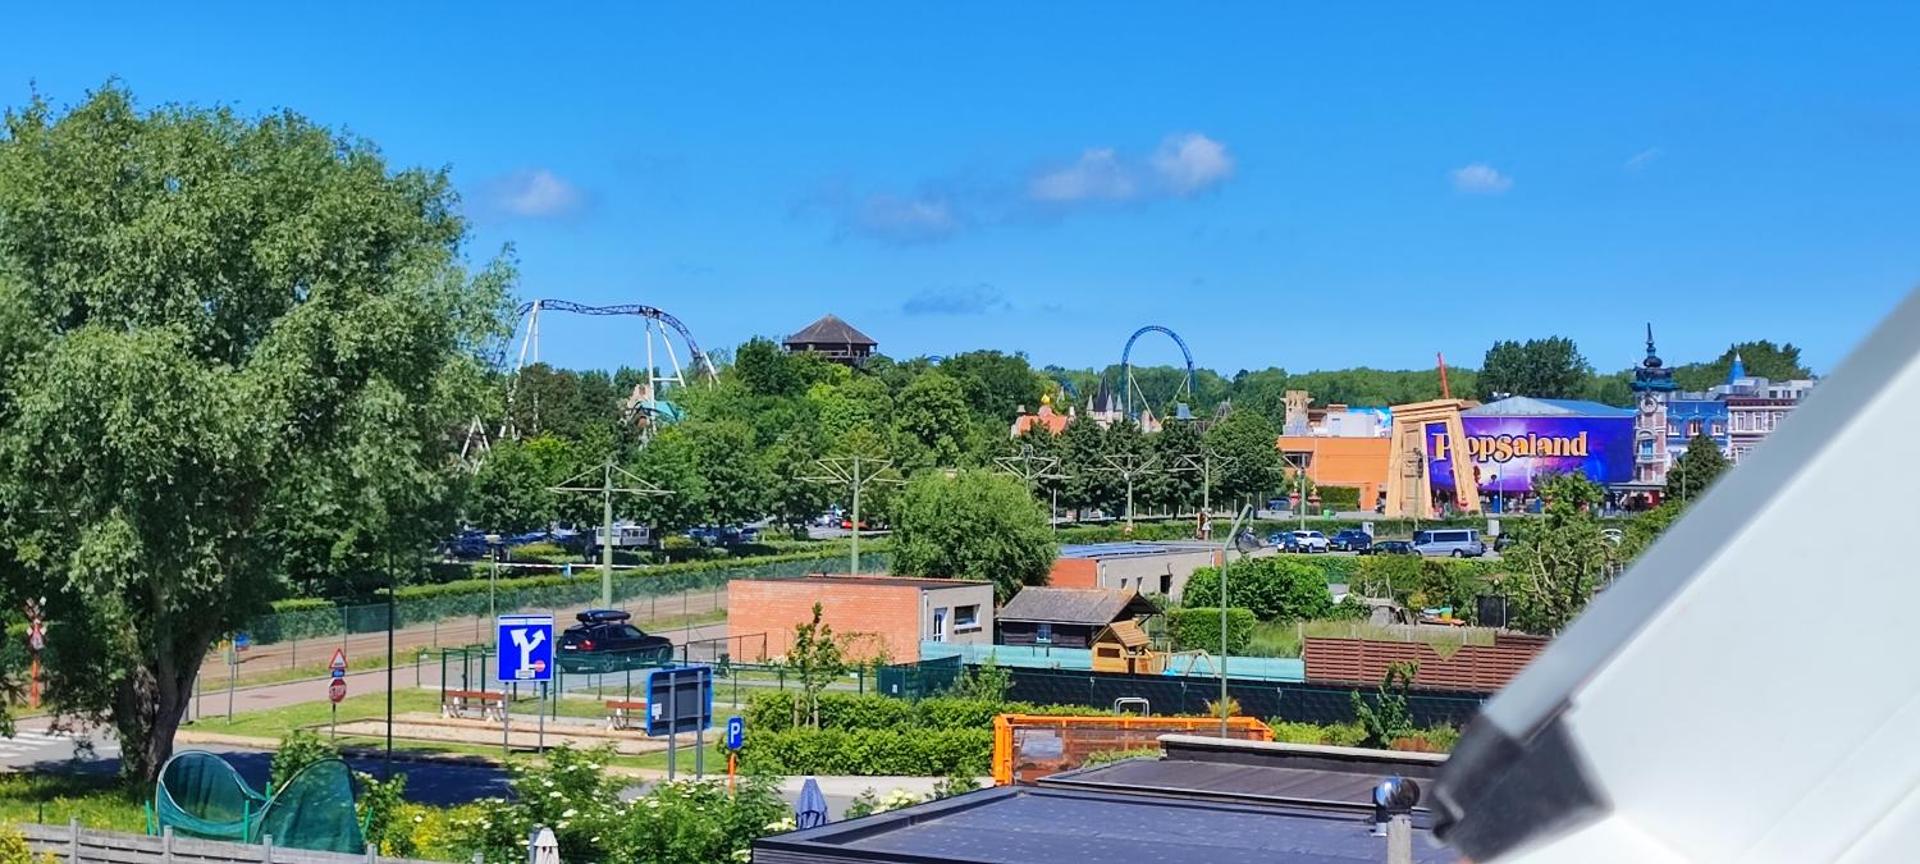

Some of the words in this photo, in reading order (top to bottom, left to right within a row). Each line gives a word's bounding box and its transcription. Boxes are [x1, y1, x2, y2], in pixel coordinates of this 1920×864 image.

[1431, 430, 1589, 463] Popsaland
[329, 684, 346, 698] STOP
[730, 722, 741, 744] P
